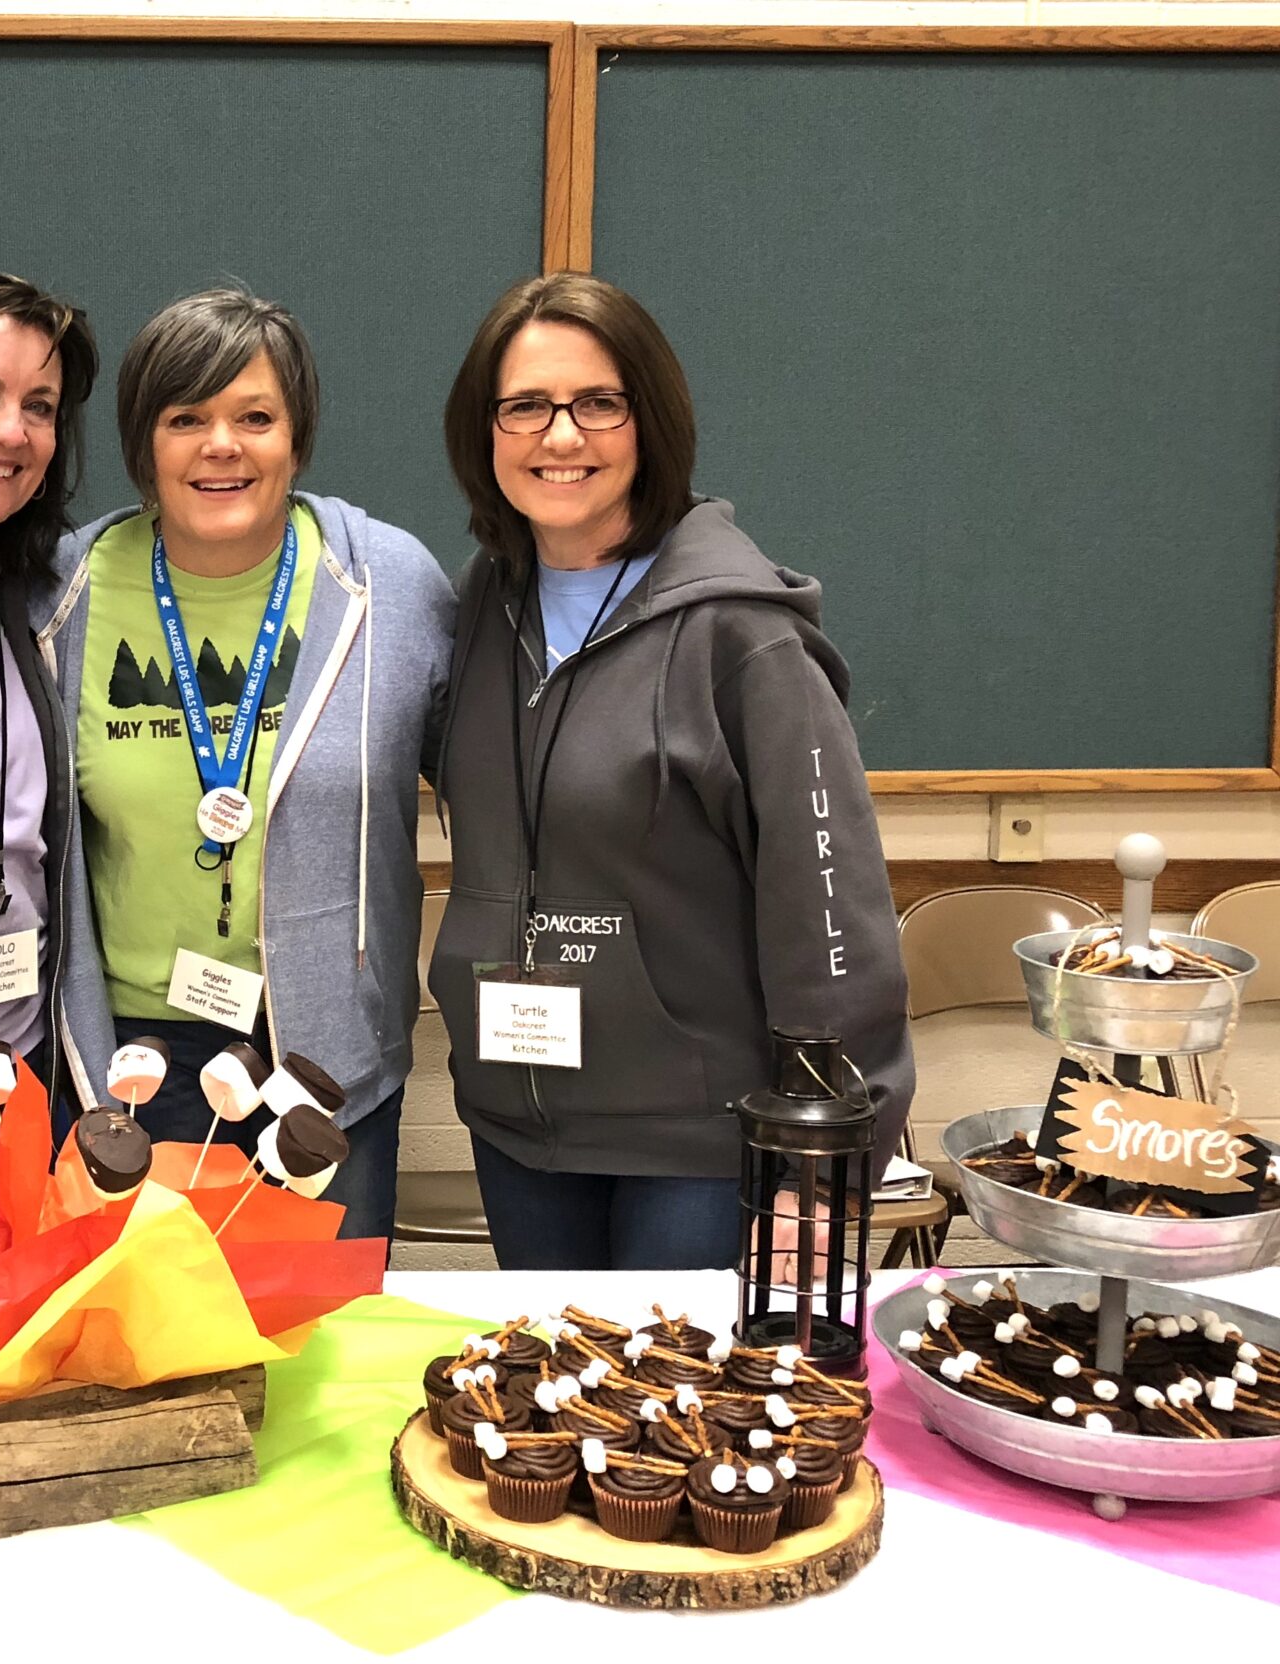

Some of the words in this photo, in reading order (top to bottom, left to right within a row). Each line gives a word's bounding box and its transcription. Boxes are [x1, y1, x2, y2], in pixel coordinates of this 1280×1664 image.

[154, 560, 165, 584] CAMP
[271, 566, 291, 610] OAKCREST
[284, 548, 294, 565] LDS
[166, 619, 186, 662] OAKCREST
[253, 644, 268, 671] CAMP
[178, 662, 190, 681] LDS
[182, 682, 197, 707] GIRLS
[245, 671, 261, 697] GIRLS
[240, 698, 253, 715] LDS
[105, 720, 143, 740] MAY
[149, 718, 182, 738] THE
[189, 708, 204, 734] CAMP
[227, 715, 248, 761] OAKCREST
[810, 748, 847, 977] TURTLE
[534, 914, 622, 935] OAKCREST
[559, 943, 597, 963] 2017
[201, 968, 232, 986] Giggles
[202, 981, 229, 994] Oakcrest
[185, 993, 207, 1008] Staff
[209, 1002, 238, 1018] Support
[187, 984, 211, 997] Women's
[212, 993, 241, 1008] Committee
[510, 1003, 548, 1018] Turtle
[492, 1030, 525, 1040] Women's
[526, 1033, 567, 1043] Committee
[512, 1020, 547, 1030] Oakcrest
[512, 1044, 548, 1055] Kitchen
[1086, 1098, 1245, 1179] Smores
